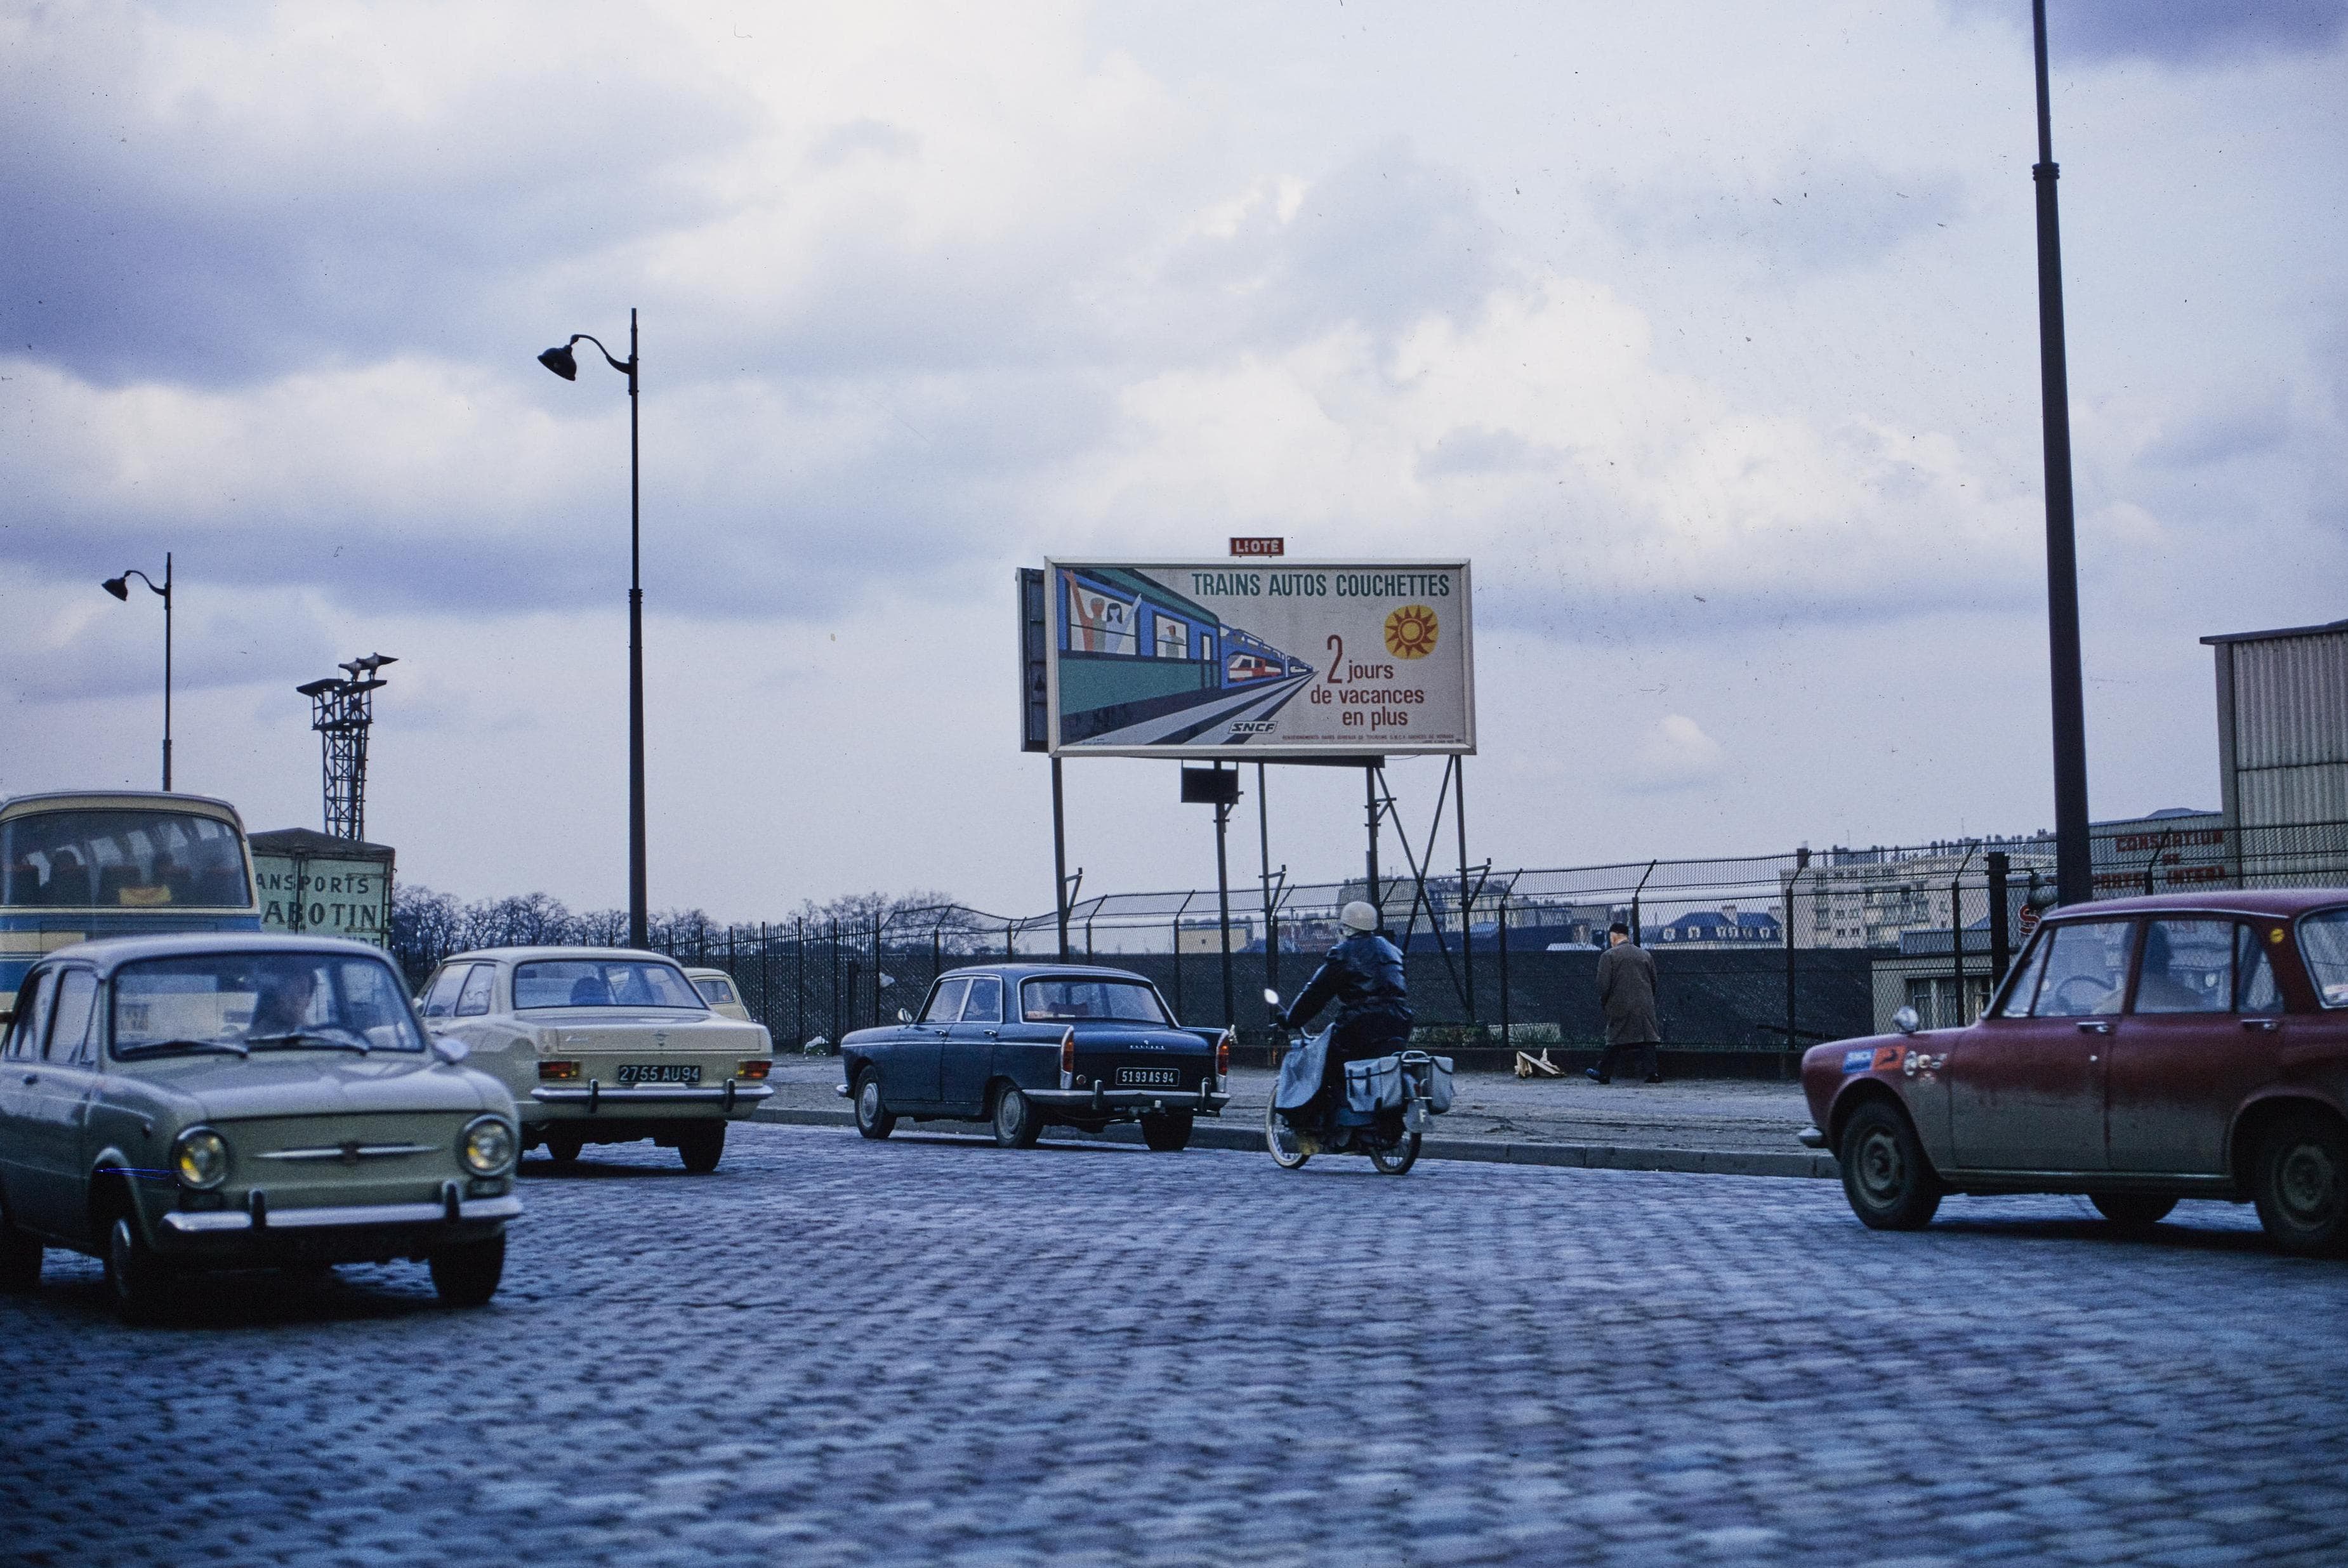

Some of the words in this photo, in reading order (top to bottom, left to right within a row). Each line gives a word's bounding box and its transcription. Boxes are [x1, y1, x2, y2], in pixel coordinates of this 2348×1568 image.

[1191, 573, 1260, 596] TRAINS
[1269, 574, 1327, 596] AUTOS
[1336, 574, 1450, 596] COUCHETTES
[1327, 635, 1343, 683] 2
[1347, 659, 1394, 683] jours
[1310, 684, 1333, 704] de
[1338, 689, 1425, 704] vacances
[1231, 723, 1276, 732] SNCF
[1342, 711, 1364, 726] en
[1371, 706, 1408, 731] plus
[620, 1067, 658, 1081] 2755
[1122, 1071, 1147, 1082] 5193
